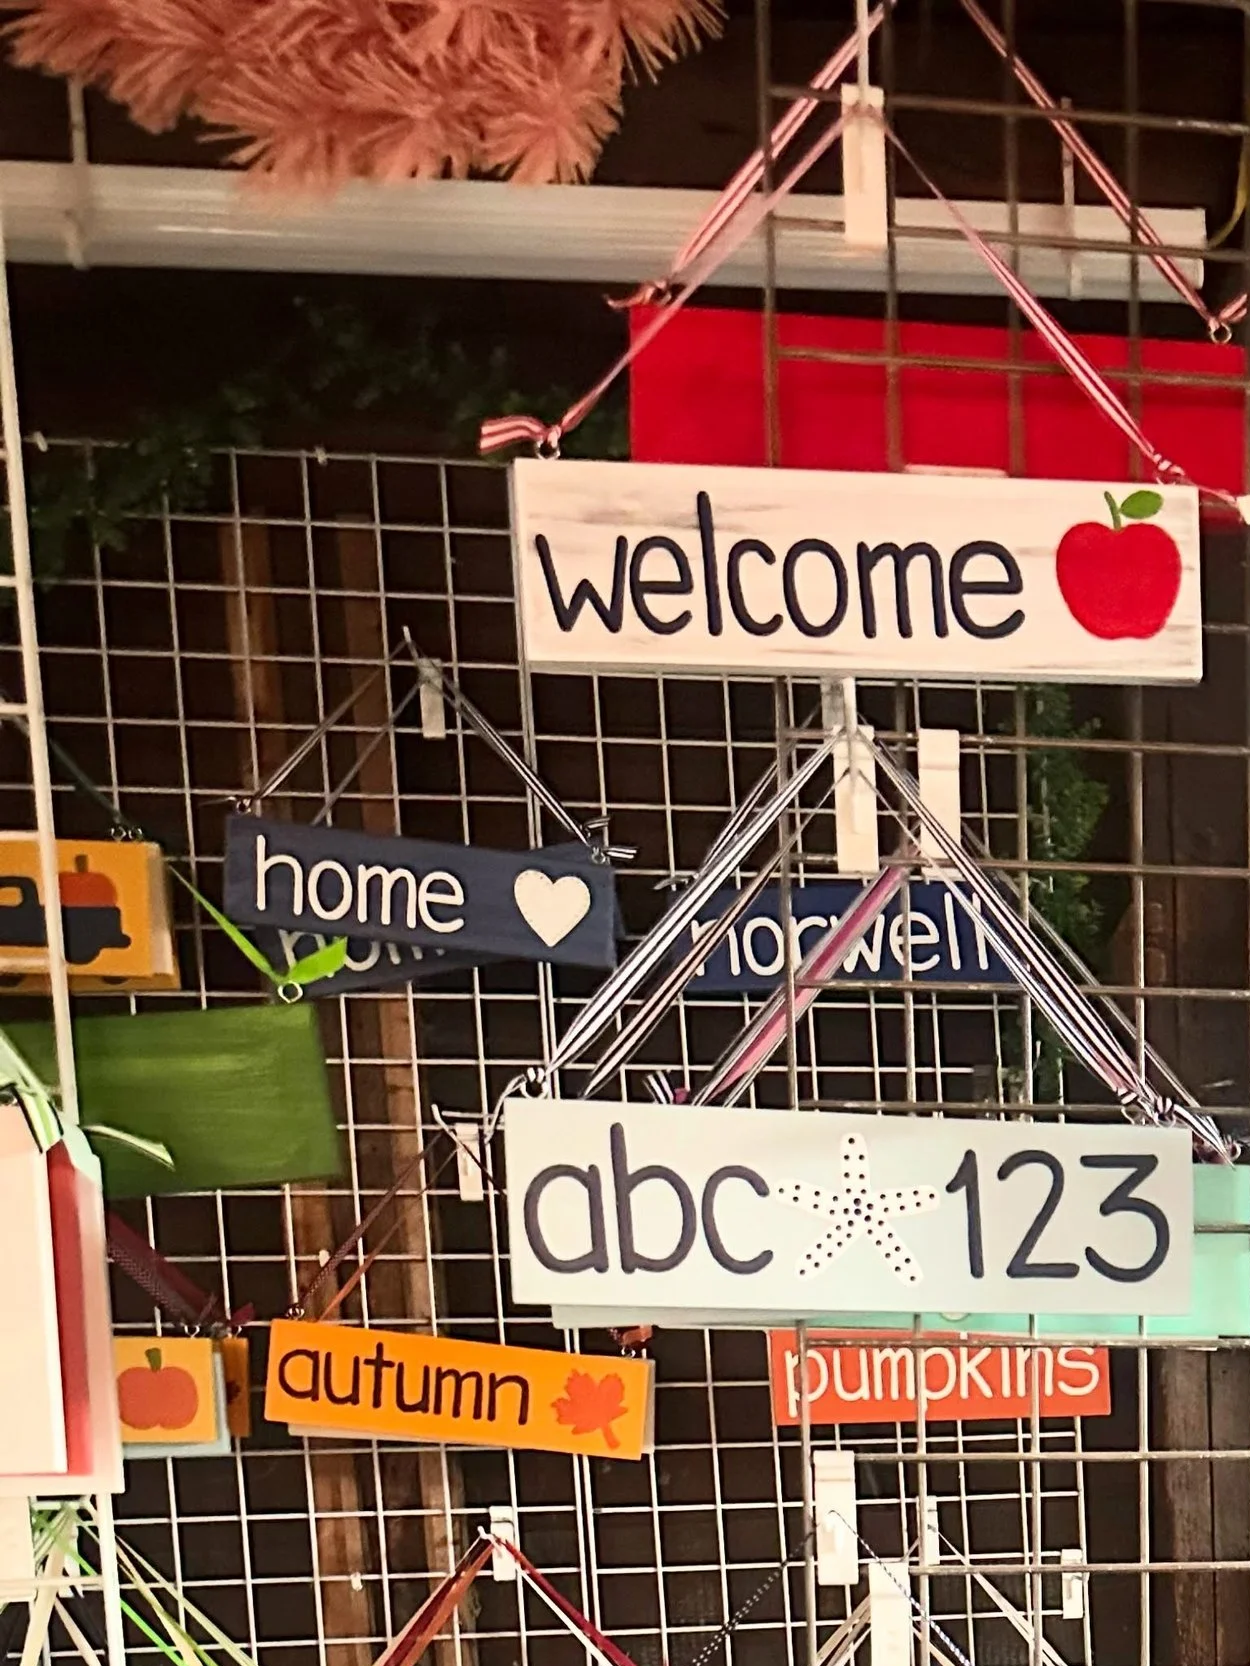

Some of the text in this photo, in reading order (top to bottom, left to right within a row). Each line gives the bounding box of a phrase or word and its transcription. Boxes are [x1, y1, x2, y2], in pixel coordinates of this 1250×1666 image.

[535, 490, 1026, 640] welcome
[256, 833, 466, 933] home
[691, 891, 990, 977] norwell
[524, 1122, 1171, 1283] abc 123
[277, 1341, 531, 1426] autumn
[785, 1346, 1100, 1418] pumpkins
